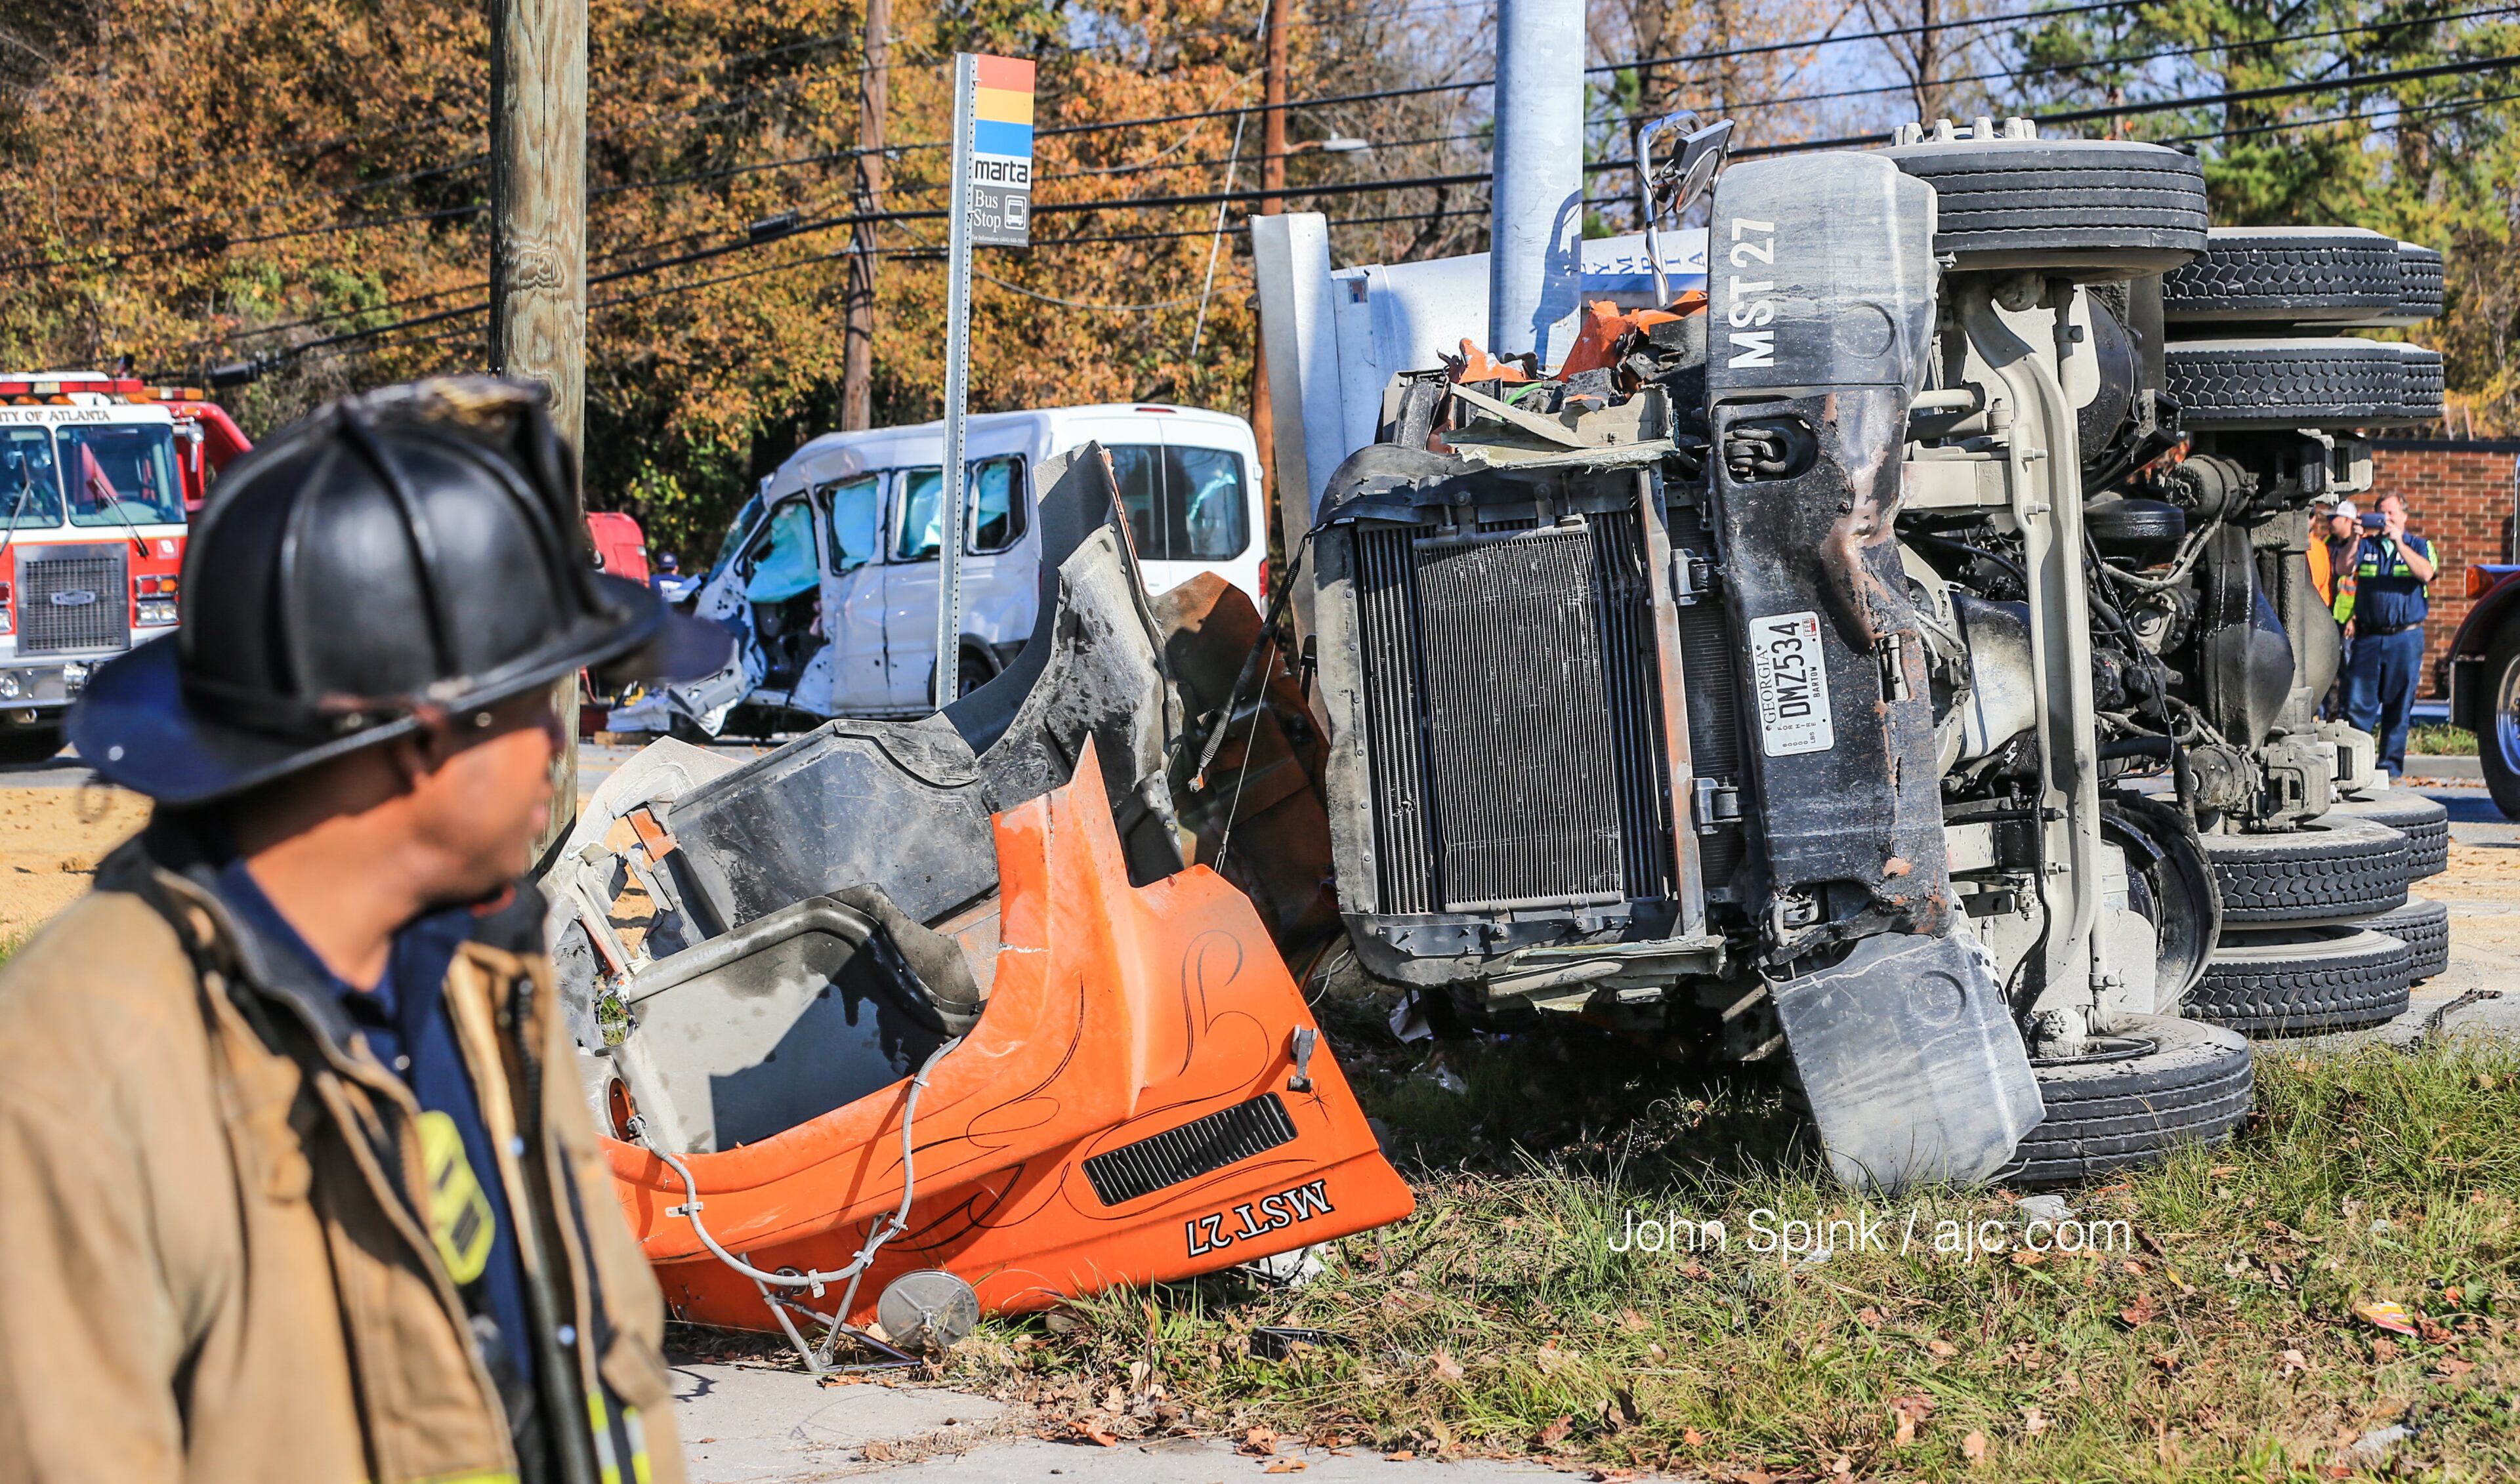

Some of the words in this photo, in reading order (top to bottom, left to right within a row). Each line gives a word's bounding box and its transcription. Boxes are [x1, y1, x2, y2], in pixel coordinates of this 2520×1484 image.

[975, 160, 1028, 183] marta
[973, 208, 1001, 233] Stop
[974, 188, 999, 209] Bus
[1729, 217, 1774, 268] 27
[1728, 275, 1774, 369] MST
[25, 411, 43, 422] OF
[49, 410, 111, 422] ATLANTA
[1756, 649, 1776, 724] GEORGIA
[1768, 622, 1811, 719] DMZ534
[1809, 666, 1820, 698] BARTOW
[1231, 1178, 1336, 1241] MST
[1185, 1212, 1234, 1259] 27
